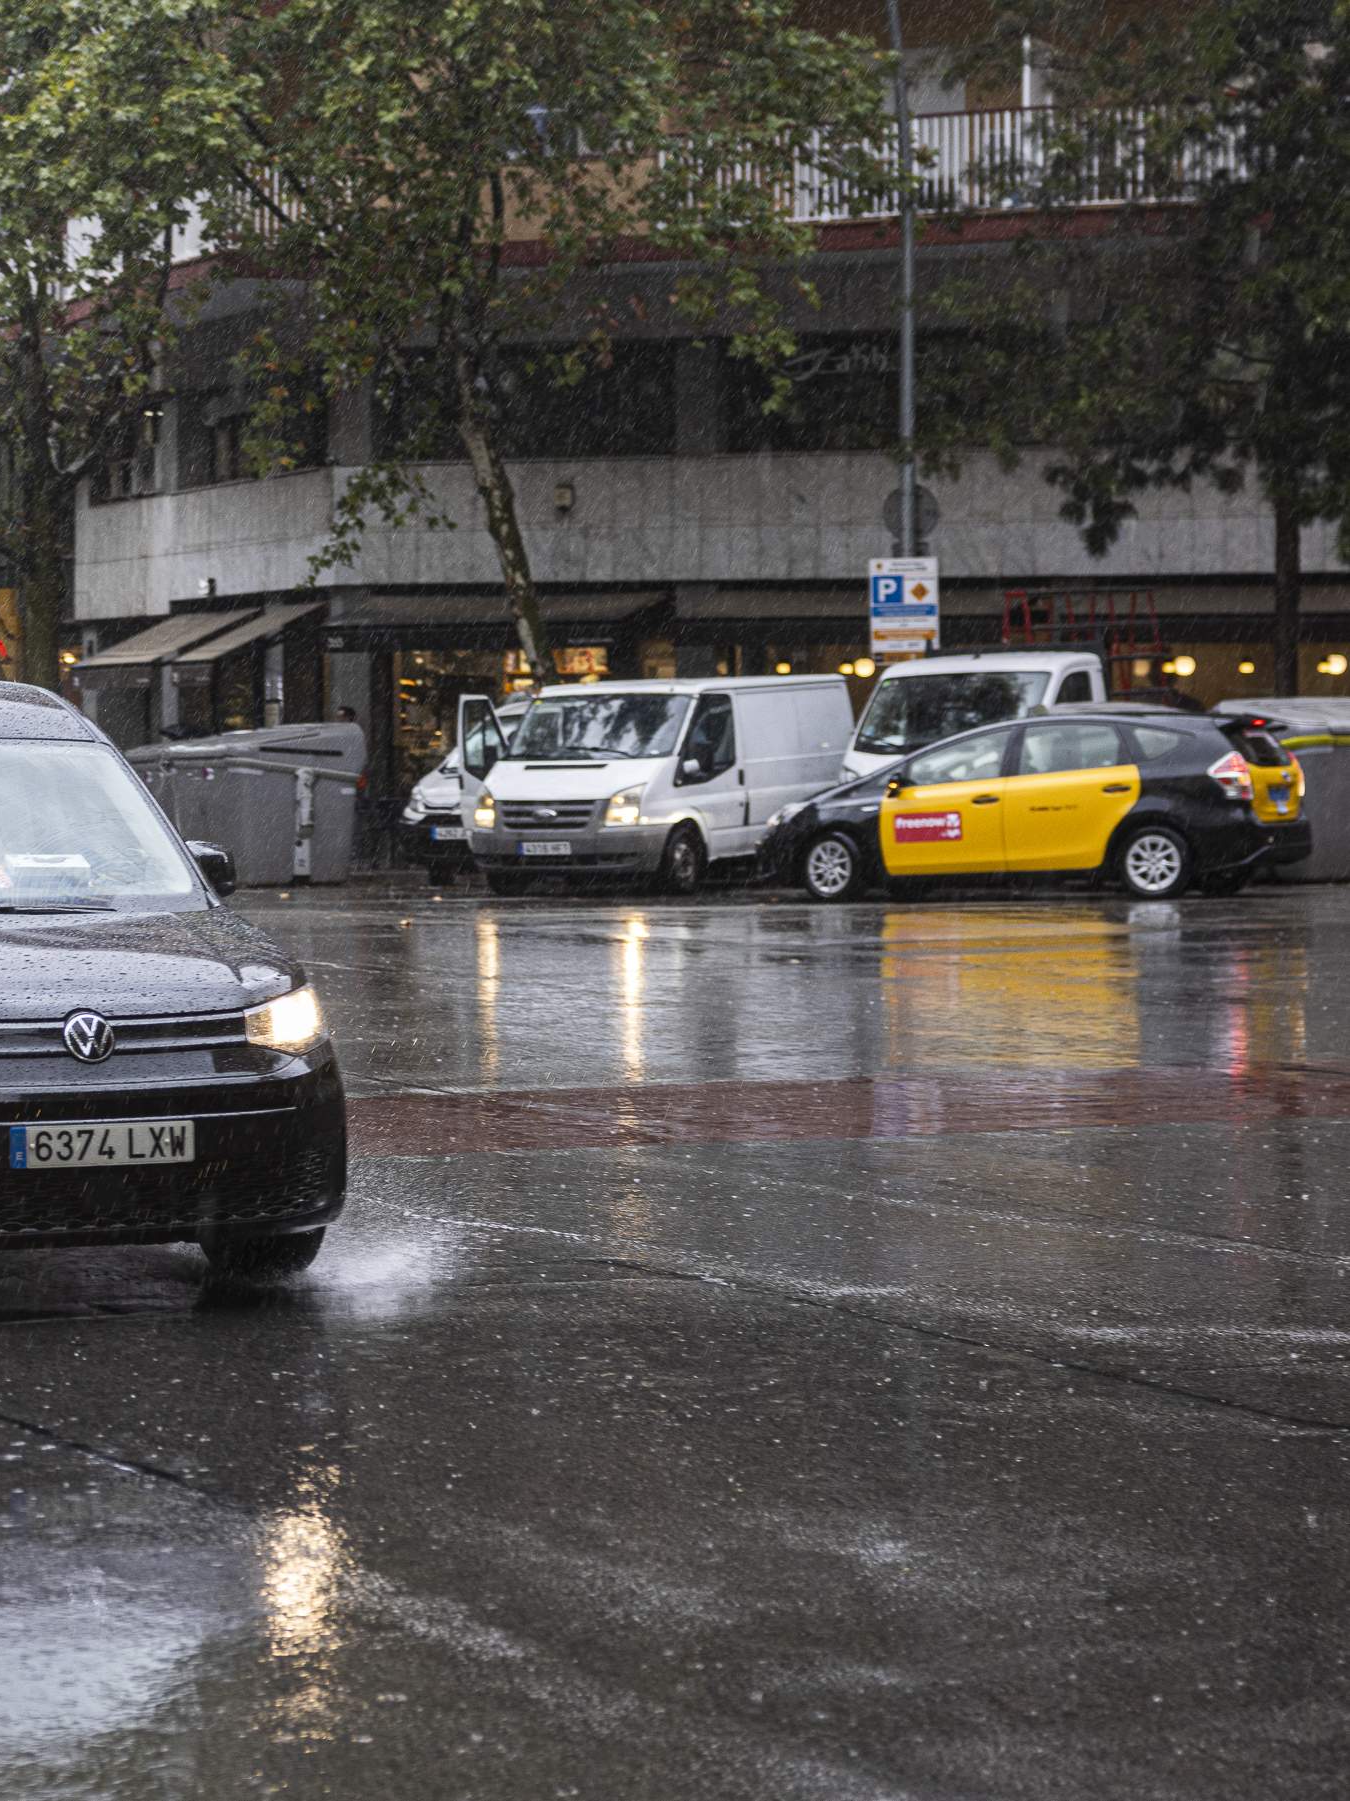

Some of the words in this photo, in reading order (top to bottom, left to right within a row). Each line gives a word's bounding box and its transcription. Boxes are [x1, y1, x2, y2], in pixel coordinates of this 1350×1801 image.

[878, 579, 897, 602] P
[895, 816, 945, 829] freenow
[35, 1128, 116, 1162] 6374
[128, 1125, 187, 1159] LXW
